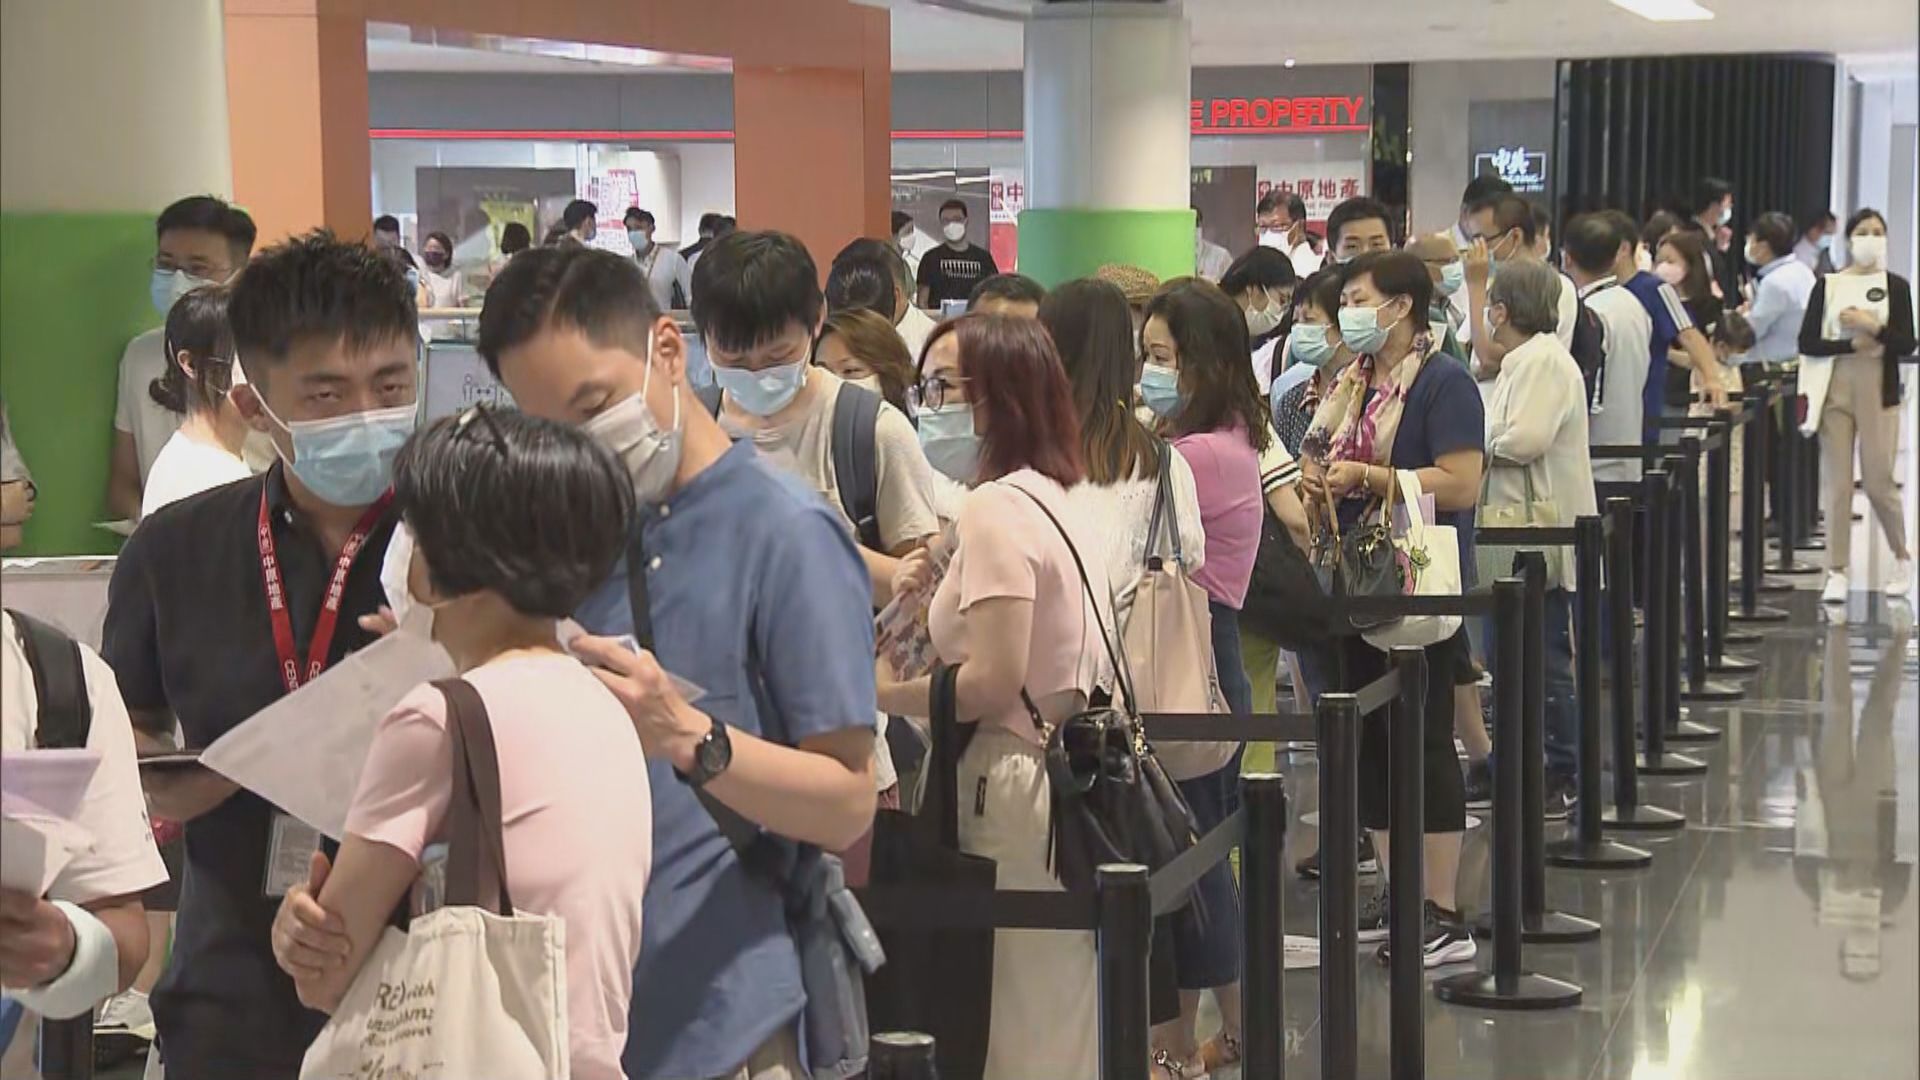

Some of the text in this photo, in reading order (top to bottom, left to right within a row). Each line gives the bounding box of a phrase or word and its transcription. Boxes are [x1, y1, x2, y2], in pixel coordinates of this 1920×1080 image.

[1211, 97, 1363, 127] PROPERTY
[1274, 179, 1359, 199] 中原地產
